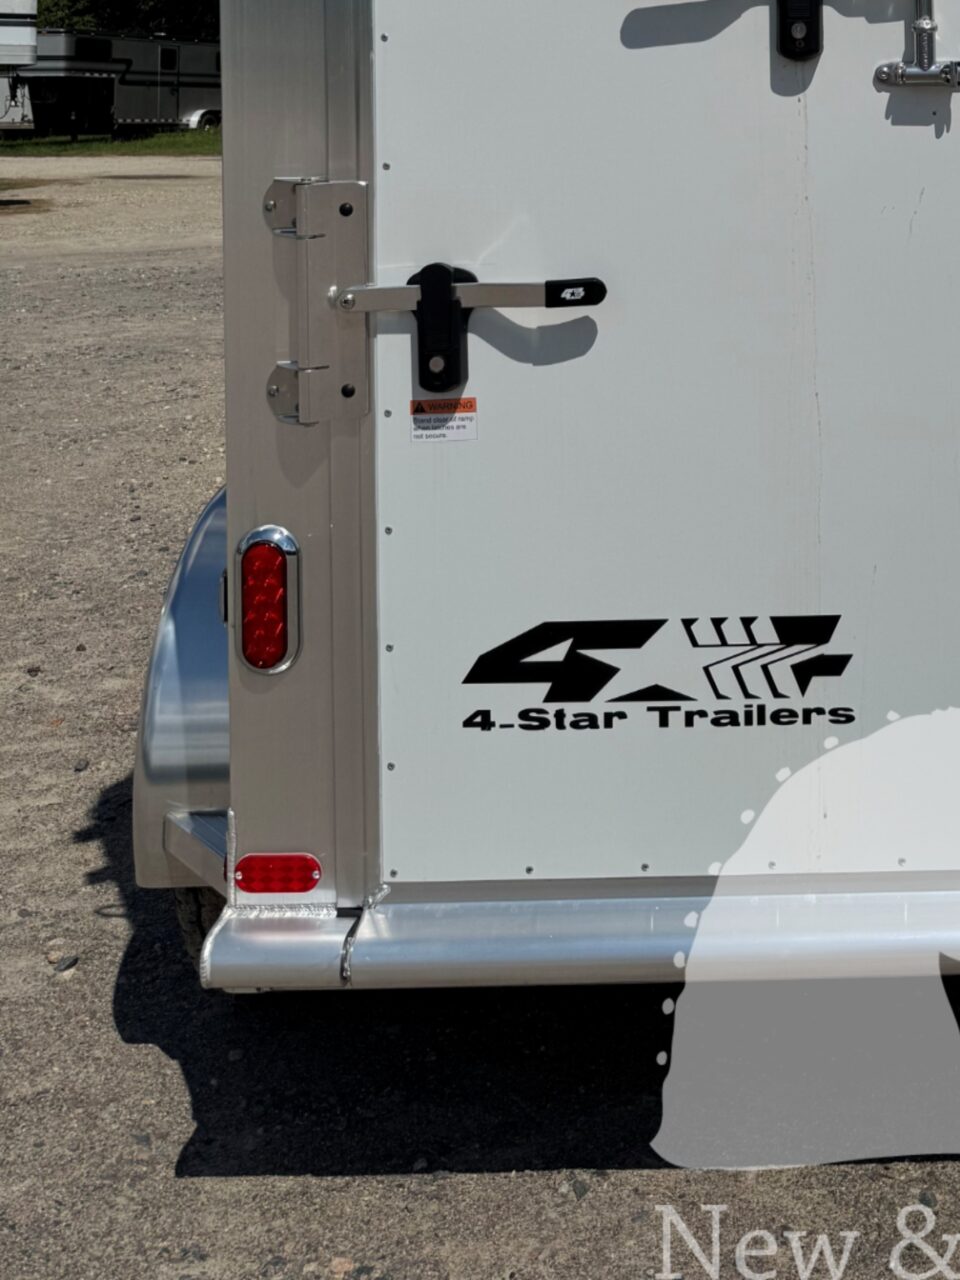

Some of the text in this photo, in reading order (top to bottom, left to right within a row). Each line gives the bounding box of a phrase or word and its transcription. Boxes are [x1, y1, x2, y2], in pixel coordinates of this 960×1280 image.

[427, 400, 474, 411] WARNING
[462, 704, 857, 732] 4-Star Trailers
